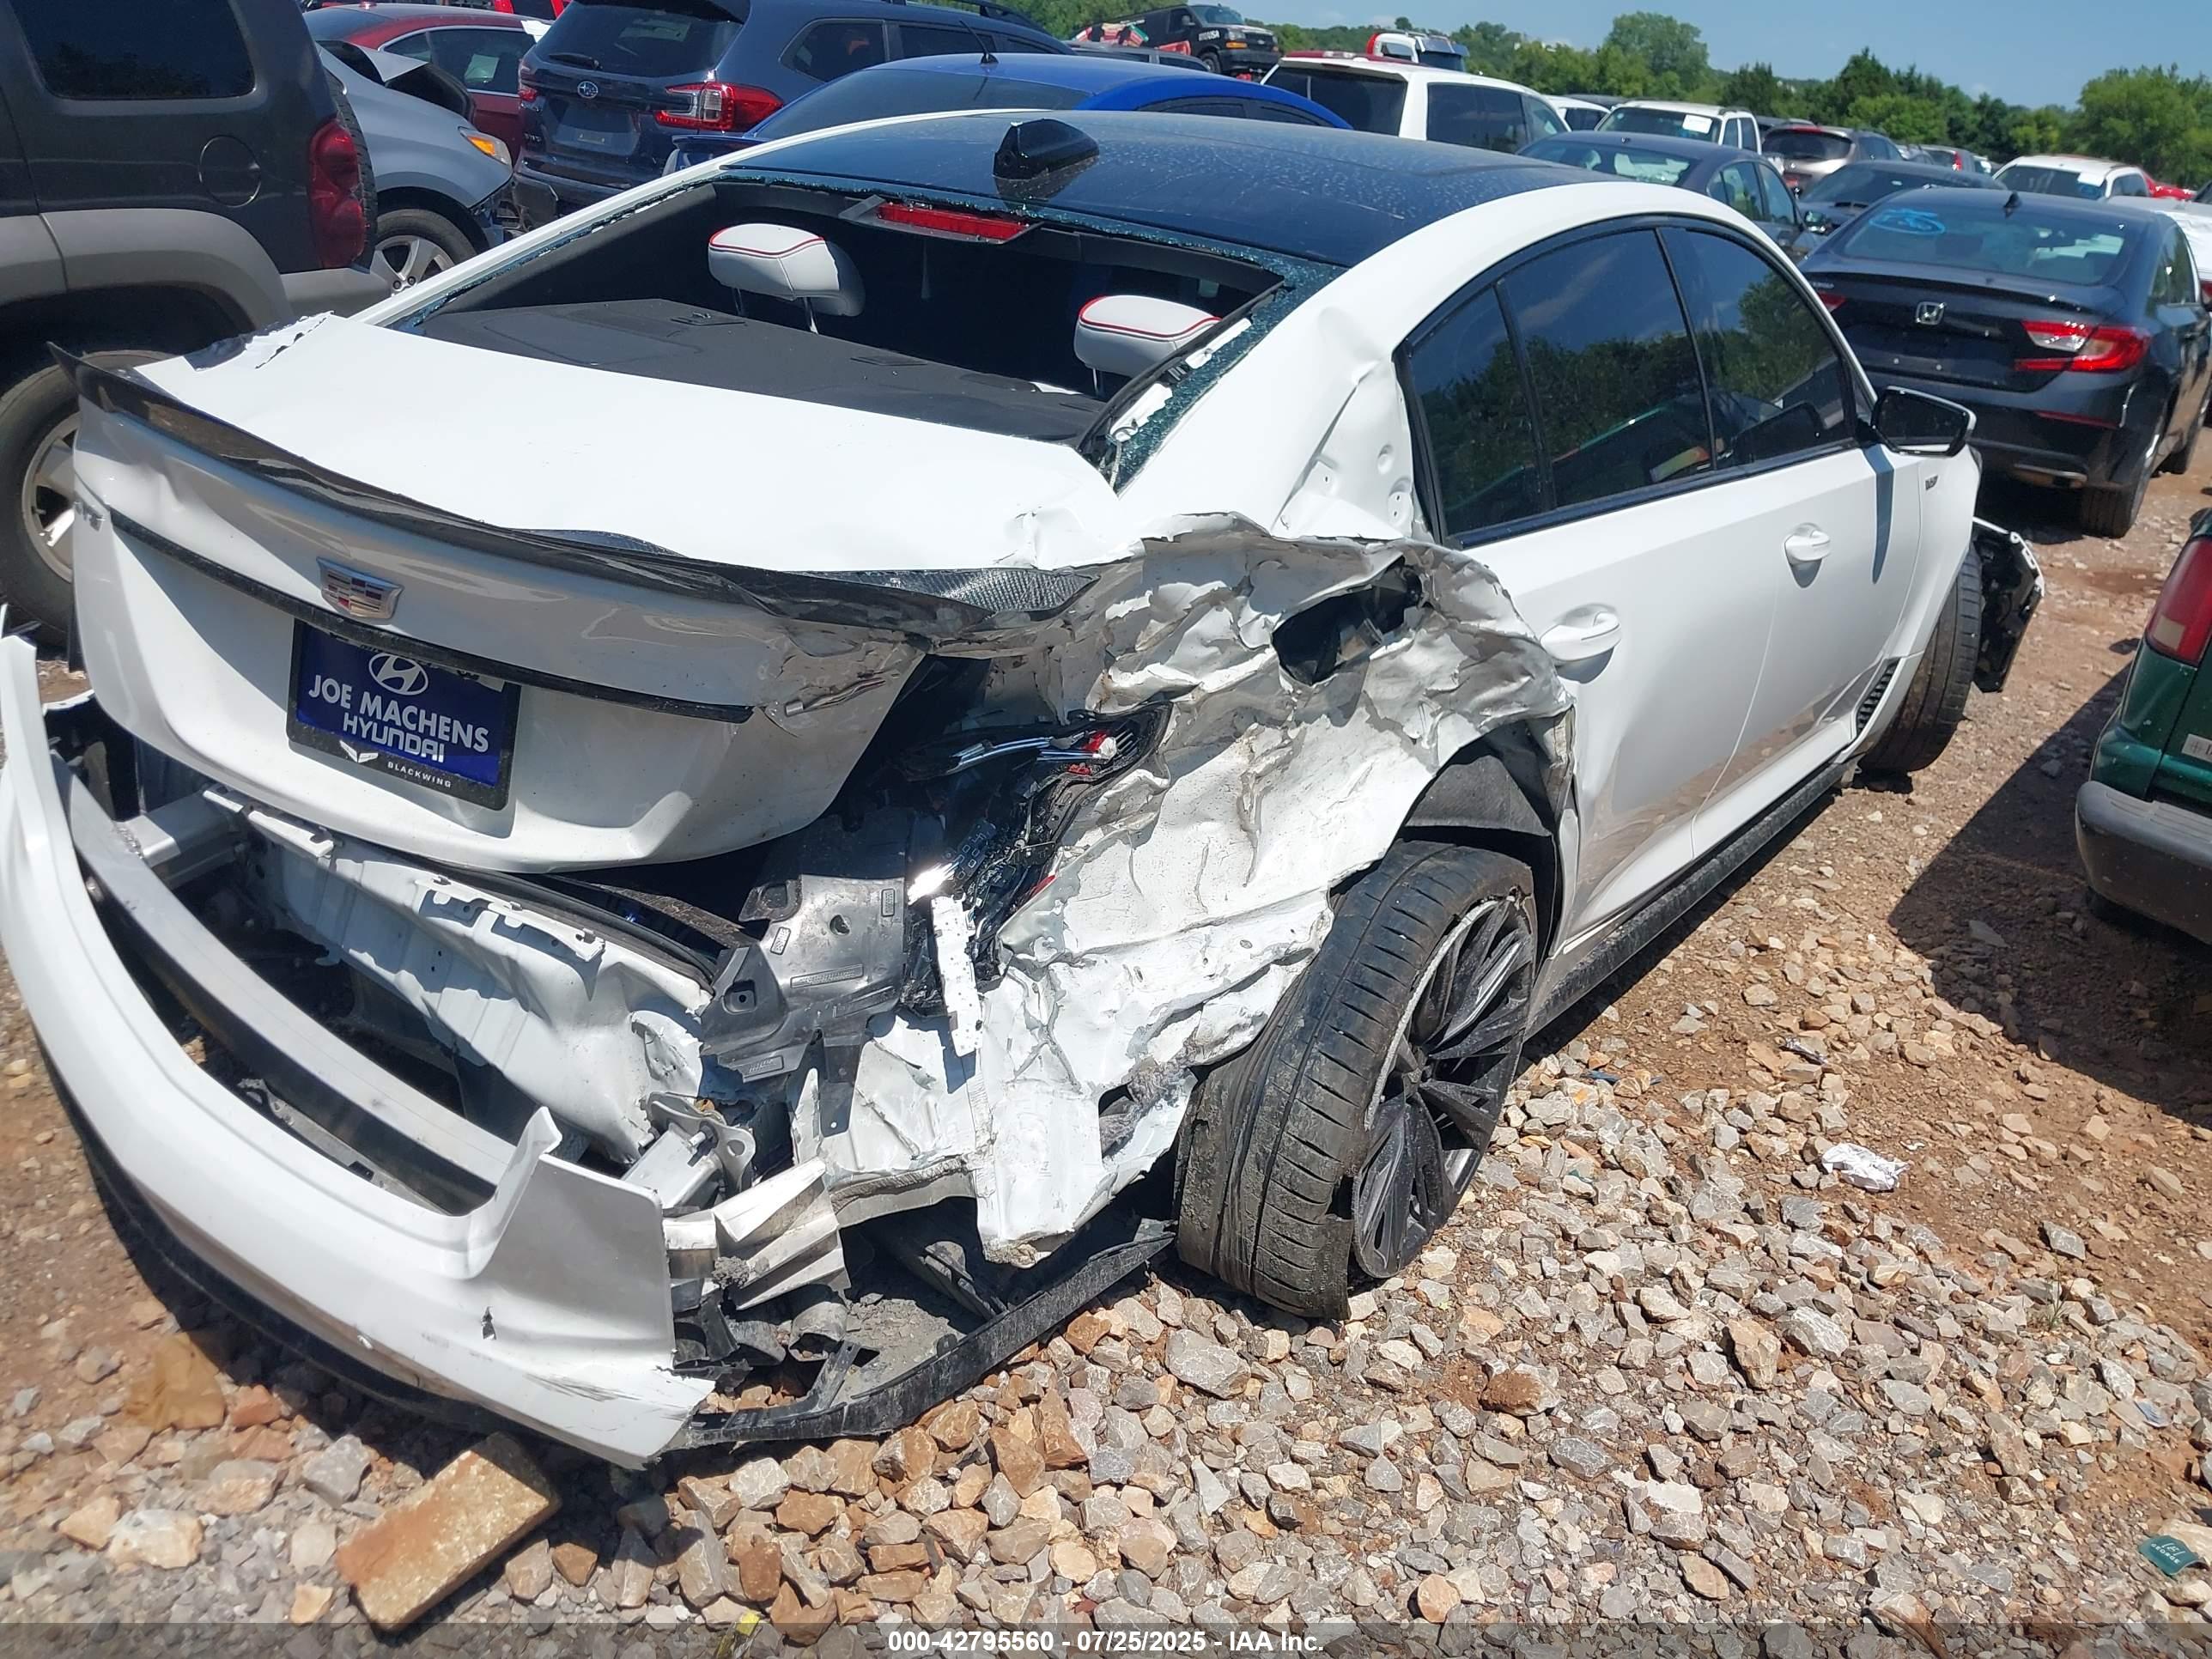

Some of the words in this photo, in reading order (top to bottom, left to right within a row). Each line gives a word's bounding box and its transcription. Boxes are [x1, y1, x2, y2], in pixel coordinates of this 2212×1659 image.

[308, 675, 351, 708] JOE
[359, 691, 489, 752] MACHENS
[343, 712, 445, 763] HYUNDAI
[387, 762, 453, 788] BLACKWING
